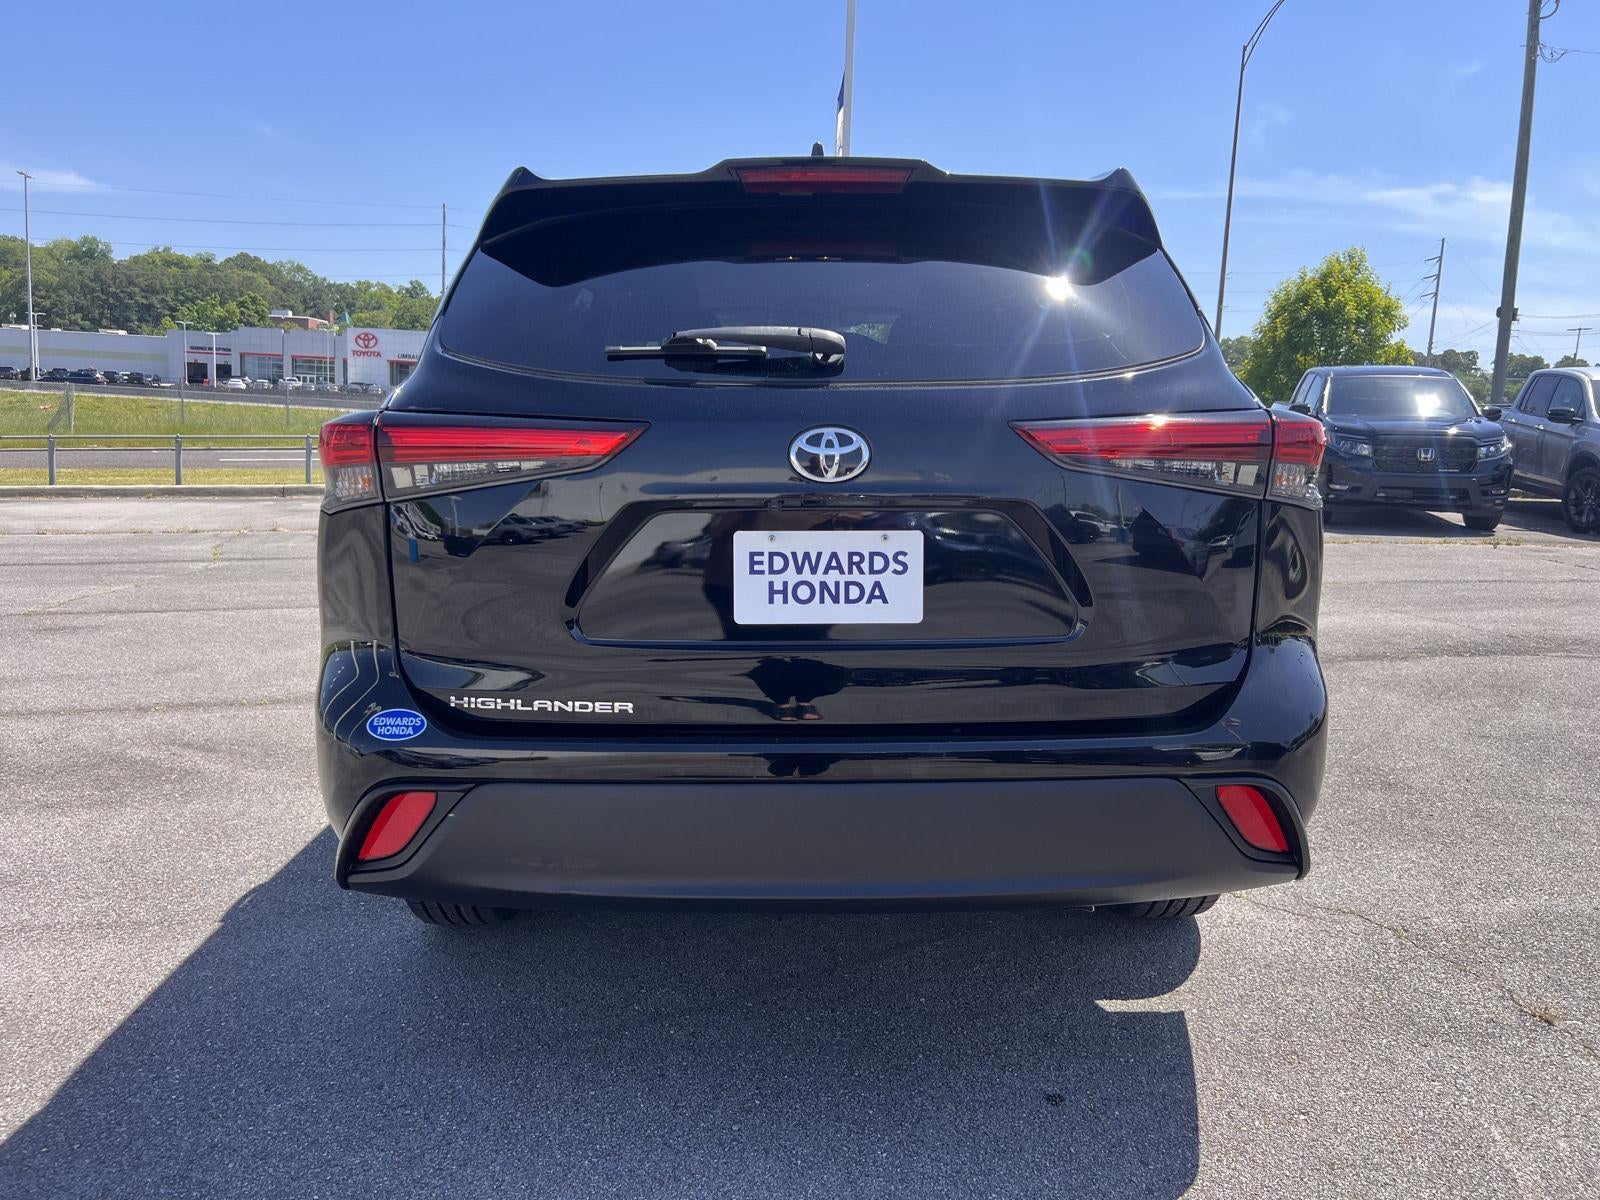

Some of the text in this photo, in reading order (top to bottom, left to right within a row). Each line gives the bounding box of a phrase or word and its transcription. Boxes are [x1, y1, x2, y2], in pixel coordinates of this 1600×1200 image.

[748, 551, 909, 576] EDWARDS
[768, 580, 889, 605] HONDA
[449, 695, 634, 714] HIGHLANDER
[373, 717, 422, 726] EDWARDS
[377, 726, 414, 735] HONDA
